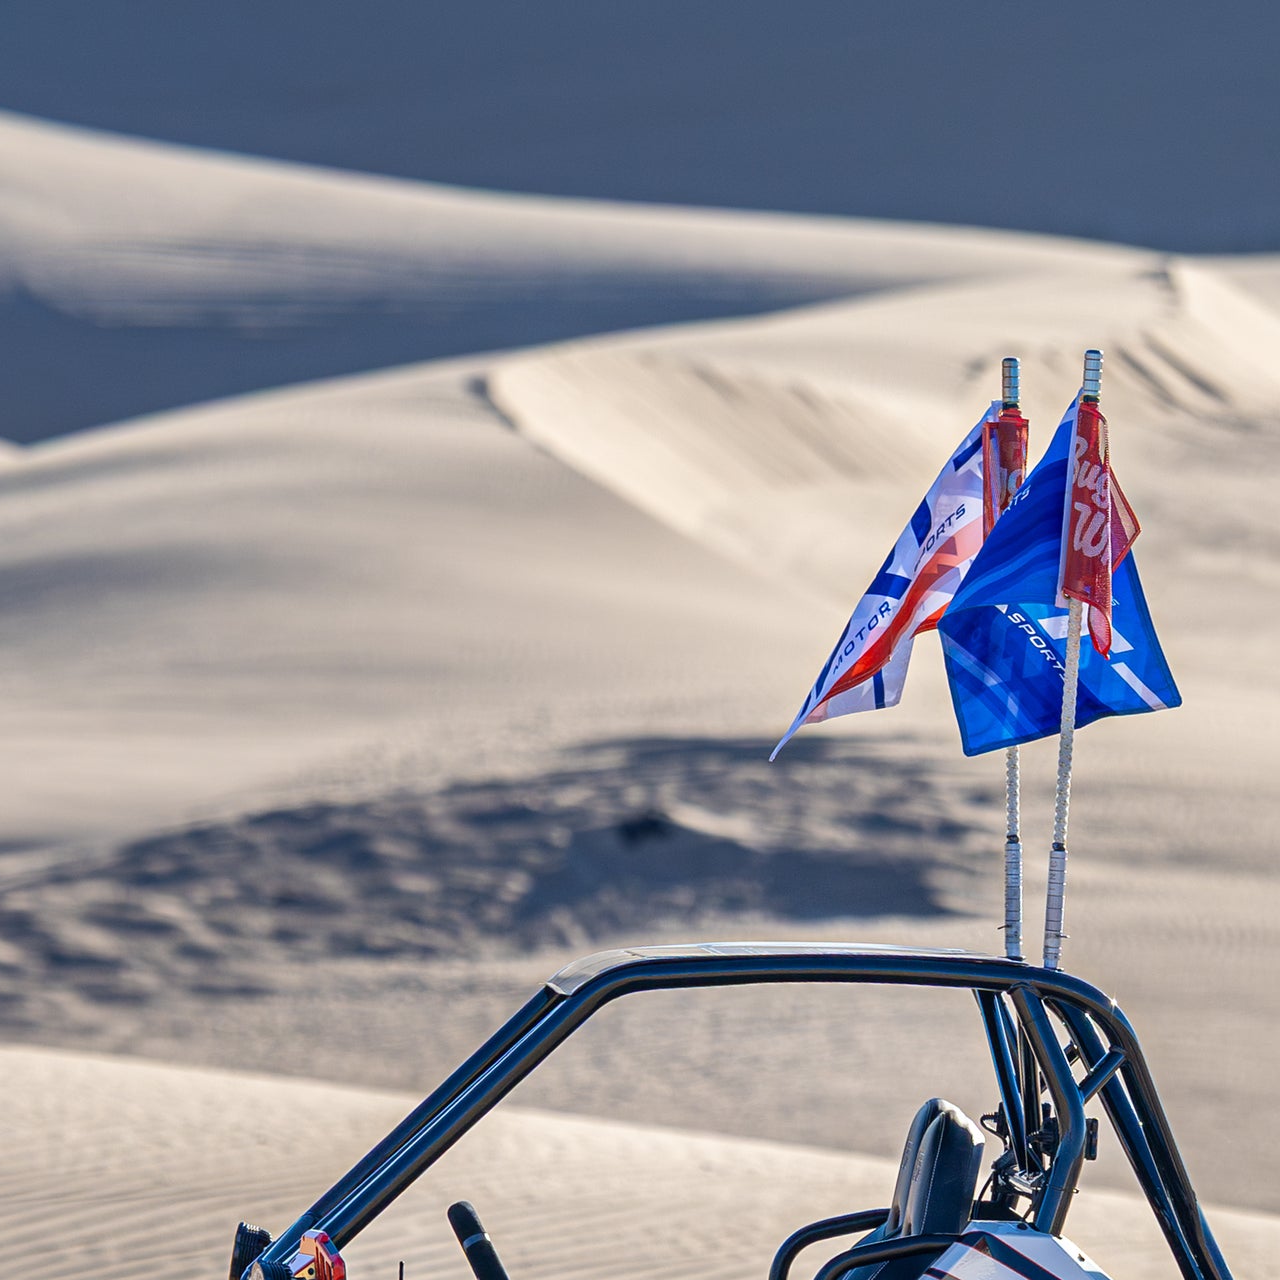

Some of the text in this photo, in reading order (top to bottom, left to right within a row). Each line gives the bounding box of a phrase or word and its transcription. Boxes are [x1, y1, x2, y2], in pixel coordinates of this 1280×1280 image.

[832, 503, 966, 675] MOTOR ORTS
[1007, 612, 1067, 682] SPORT
